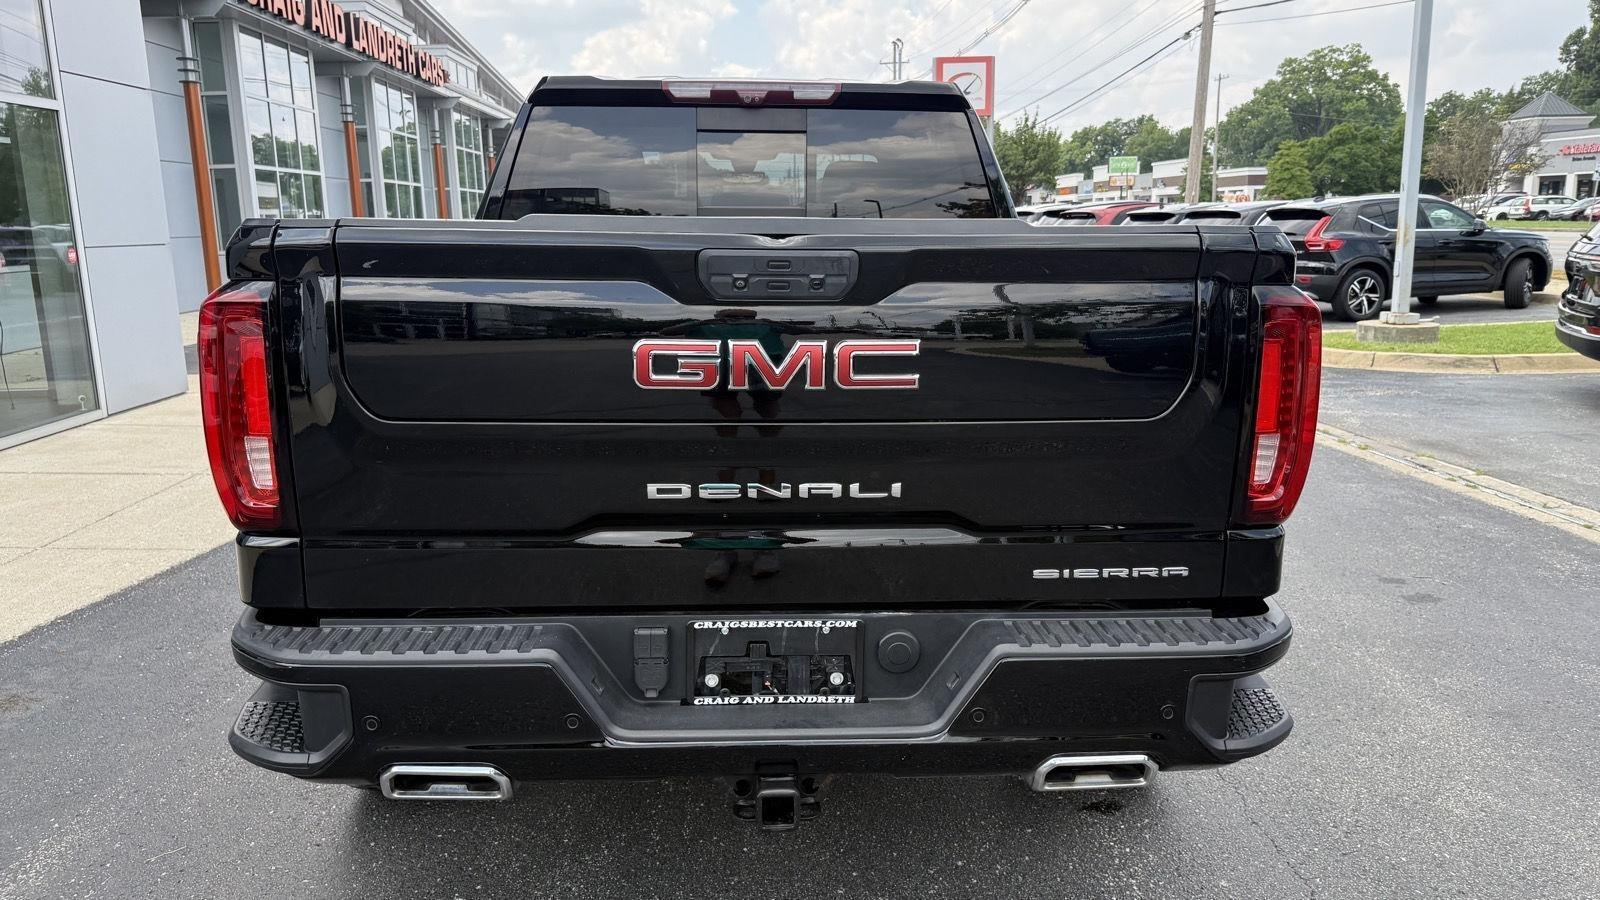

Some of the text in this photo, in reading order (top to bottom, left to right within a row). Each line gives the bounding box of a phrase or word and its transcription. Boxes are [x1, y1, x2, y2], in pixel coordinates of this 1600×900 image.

[247, 0, 444, 87] AIG AND LANDRETH CARS
[632, 339, 921, 389] GMC
[647, 482, 902, 499] DENALI
[1032, 566, 1189, 579] SIERRA
[693, 620, 858, 629] CRAIGSBESTCARS.COM
[693, 697, 741, 705] CRAIG
[775, 696, 856, 704] LANDRETH
